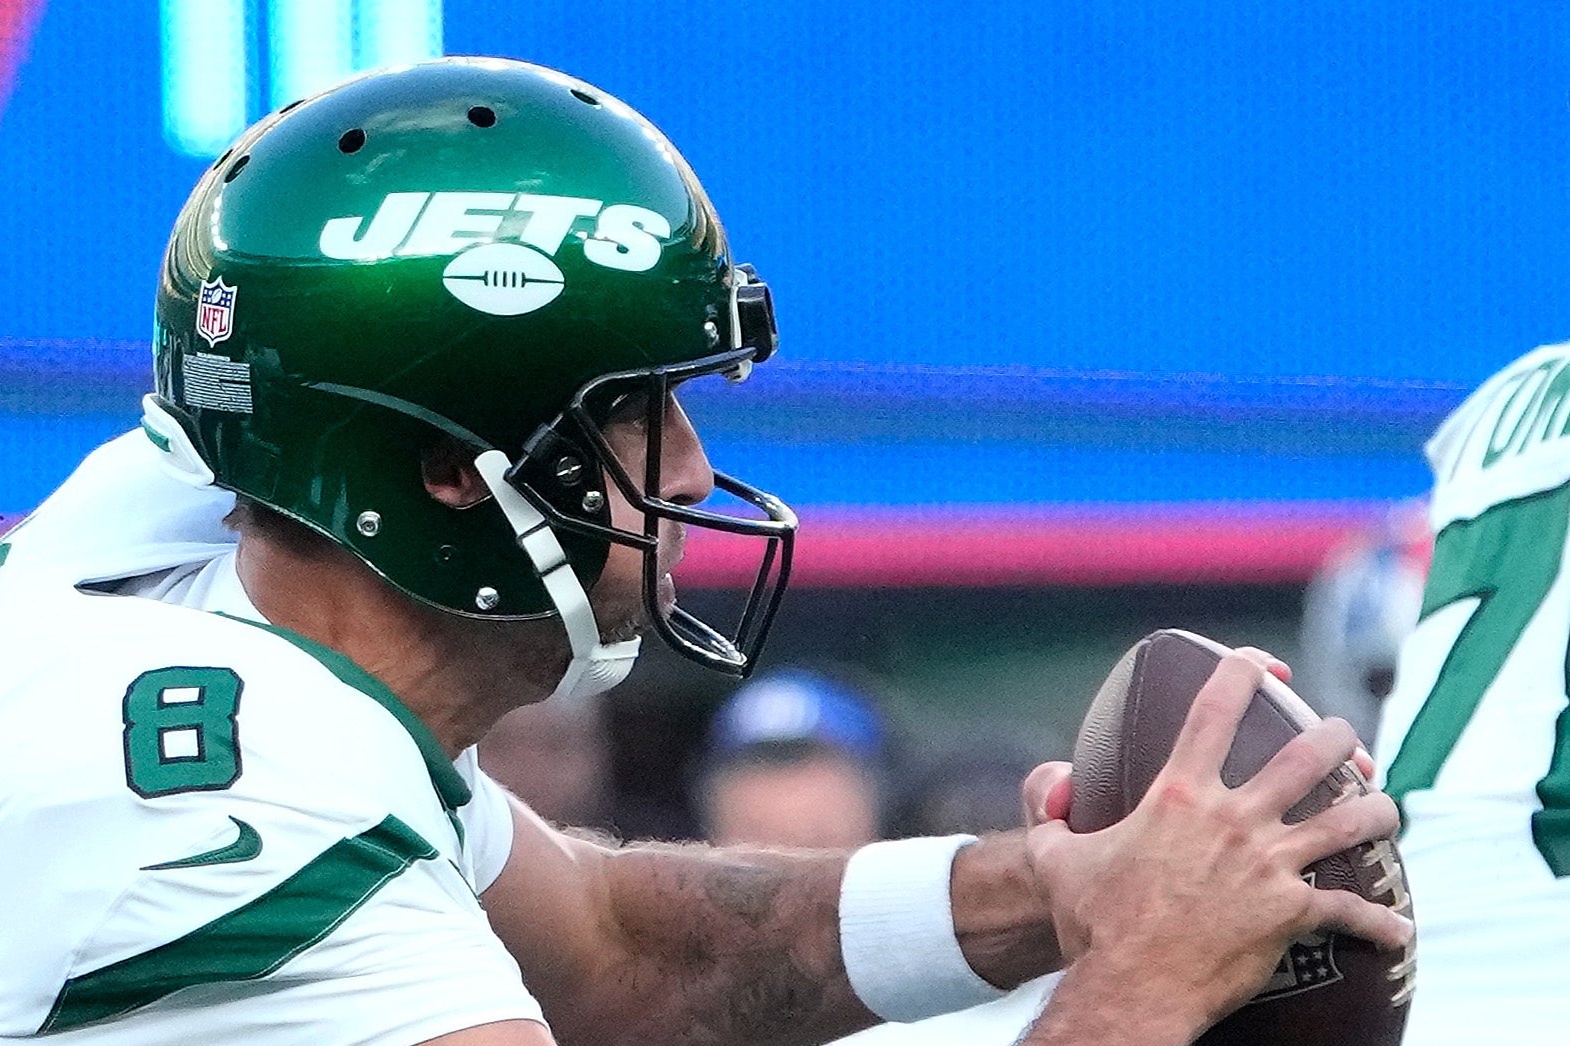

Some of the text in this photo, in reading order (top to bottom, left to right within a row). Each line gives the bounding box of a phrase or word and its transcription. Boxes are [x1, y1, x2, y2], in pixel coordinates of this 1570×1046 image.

[319, 191, 671, 272] JETS
[201, 304, 228, 335] NFL
[122, 665, 245, 800] 8
[1380, 482, 1570, 880] 7
